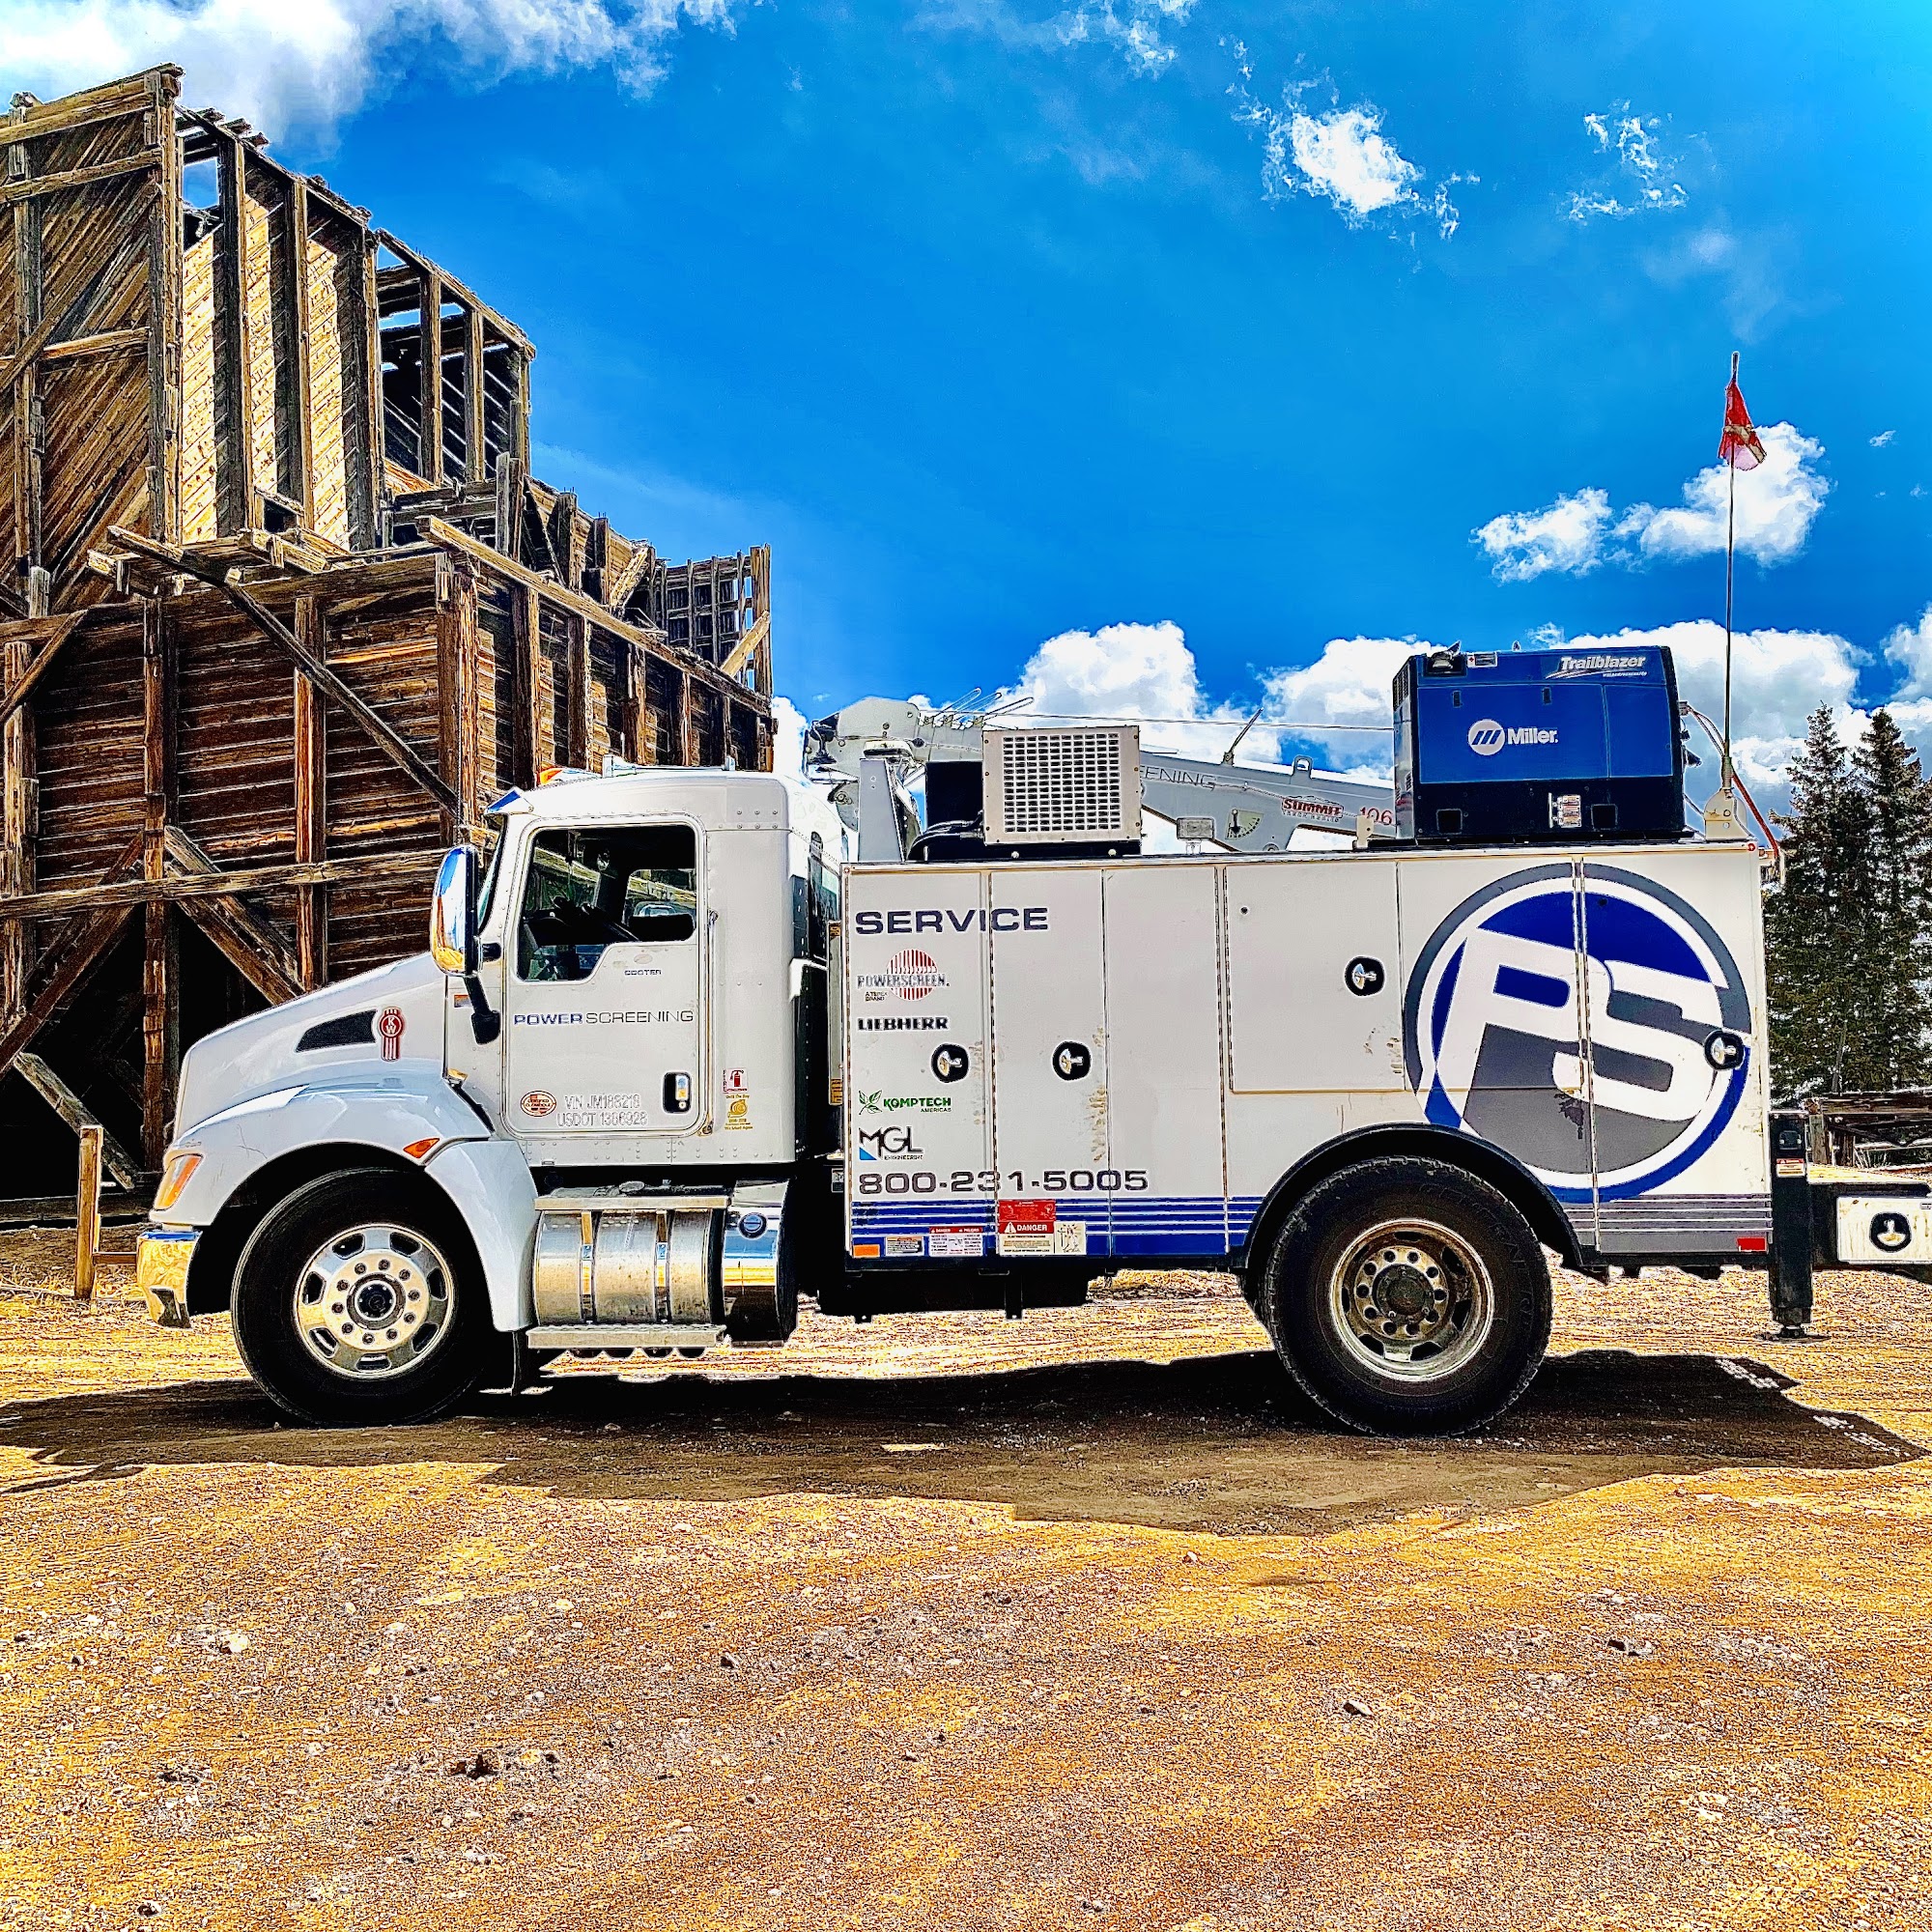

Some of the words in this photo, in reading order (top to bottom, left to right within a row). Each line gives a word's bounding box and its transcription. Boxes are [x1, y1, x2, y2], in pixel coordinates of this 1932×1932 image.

[1561, 656, 1646, 670] Trailblazer
[855, 907, 1049, 935] SERVICE
[514, 1014, 582, 1026] POWER
[585, 1010, 694, 1024] SCREENING
[858, 1017, 949, 1031] LIEBHERR
[564, 1094, 583, 1110] VIN
[883, 1097, 952, 1111] KOMPTECH
[557, 1112, 597, 1127] USDOT
[858, 1125, 923, 1160] MGL
[858, 1170, 1149, 1194] 800-231-5005
